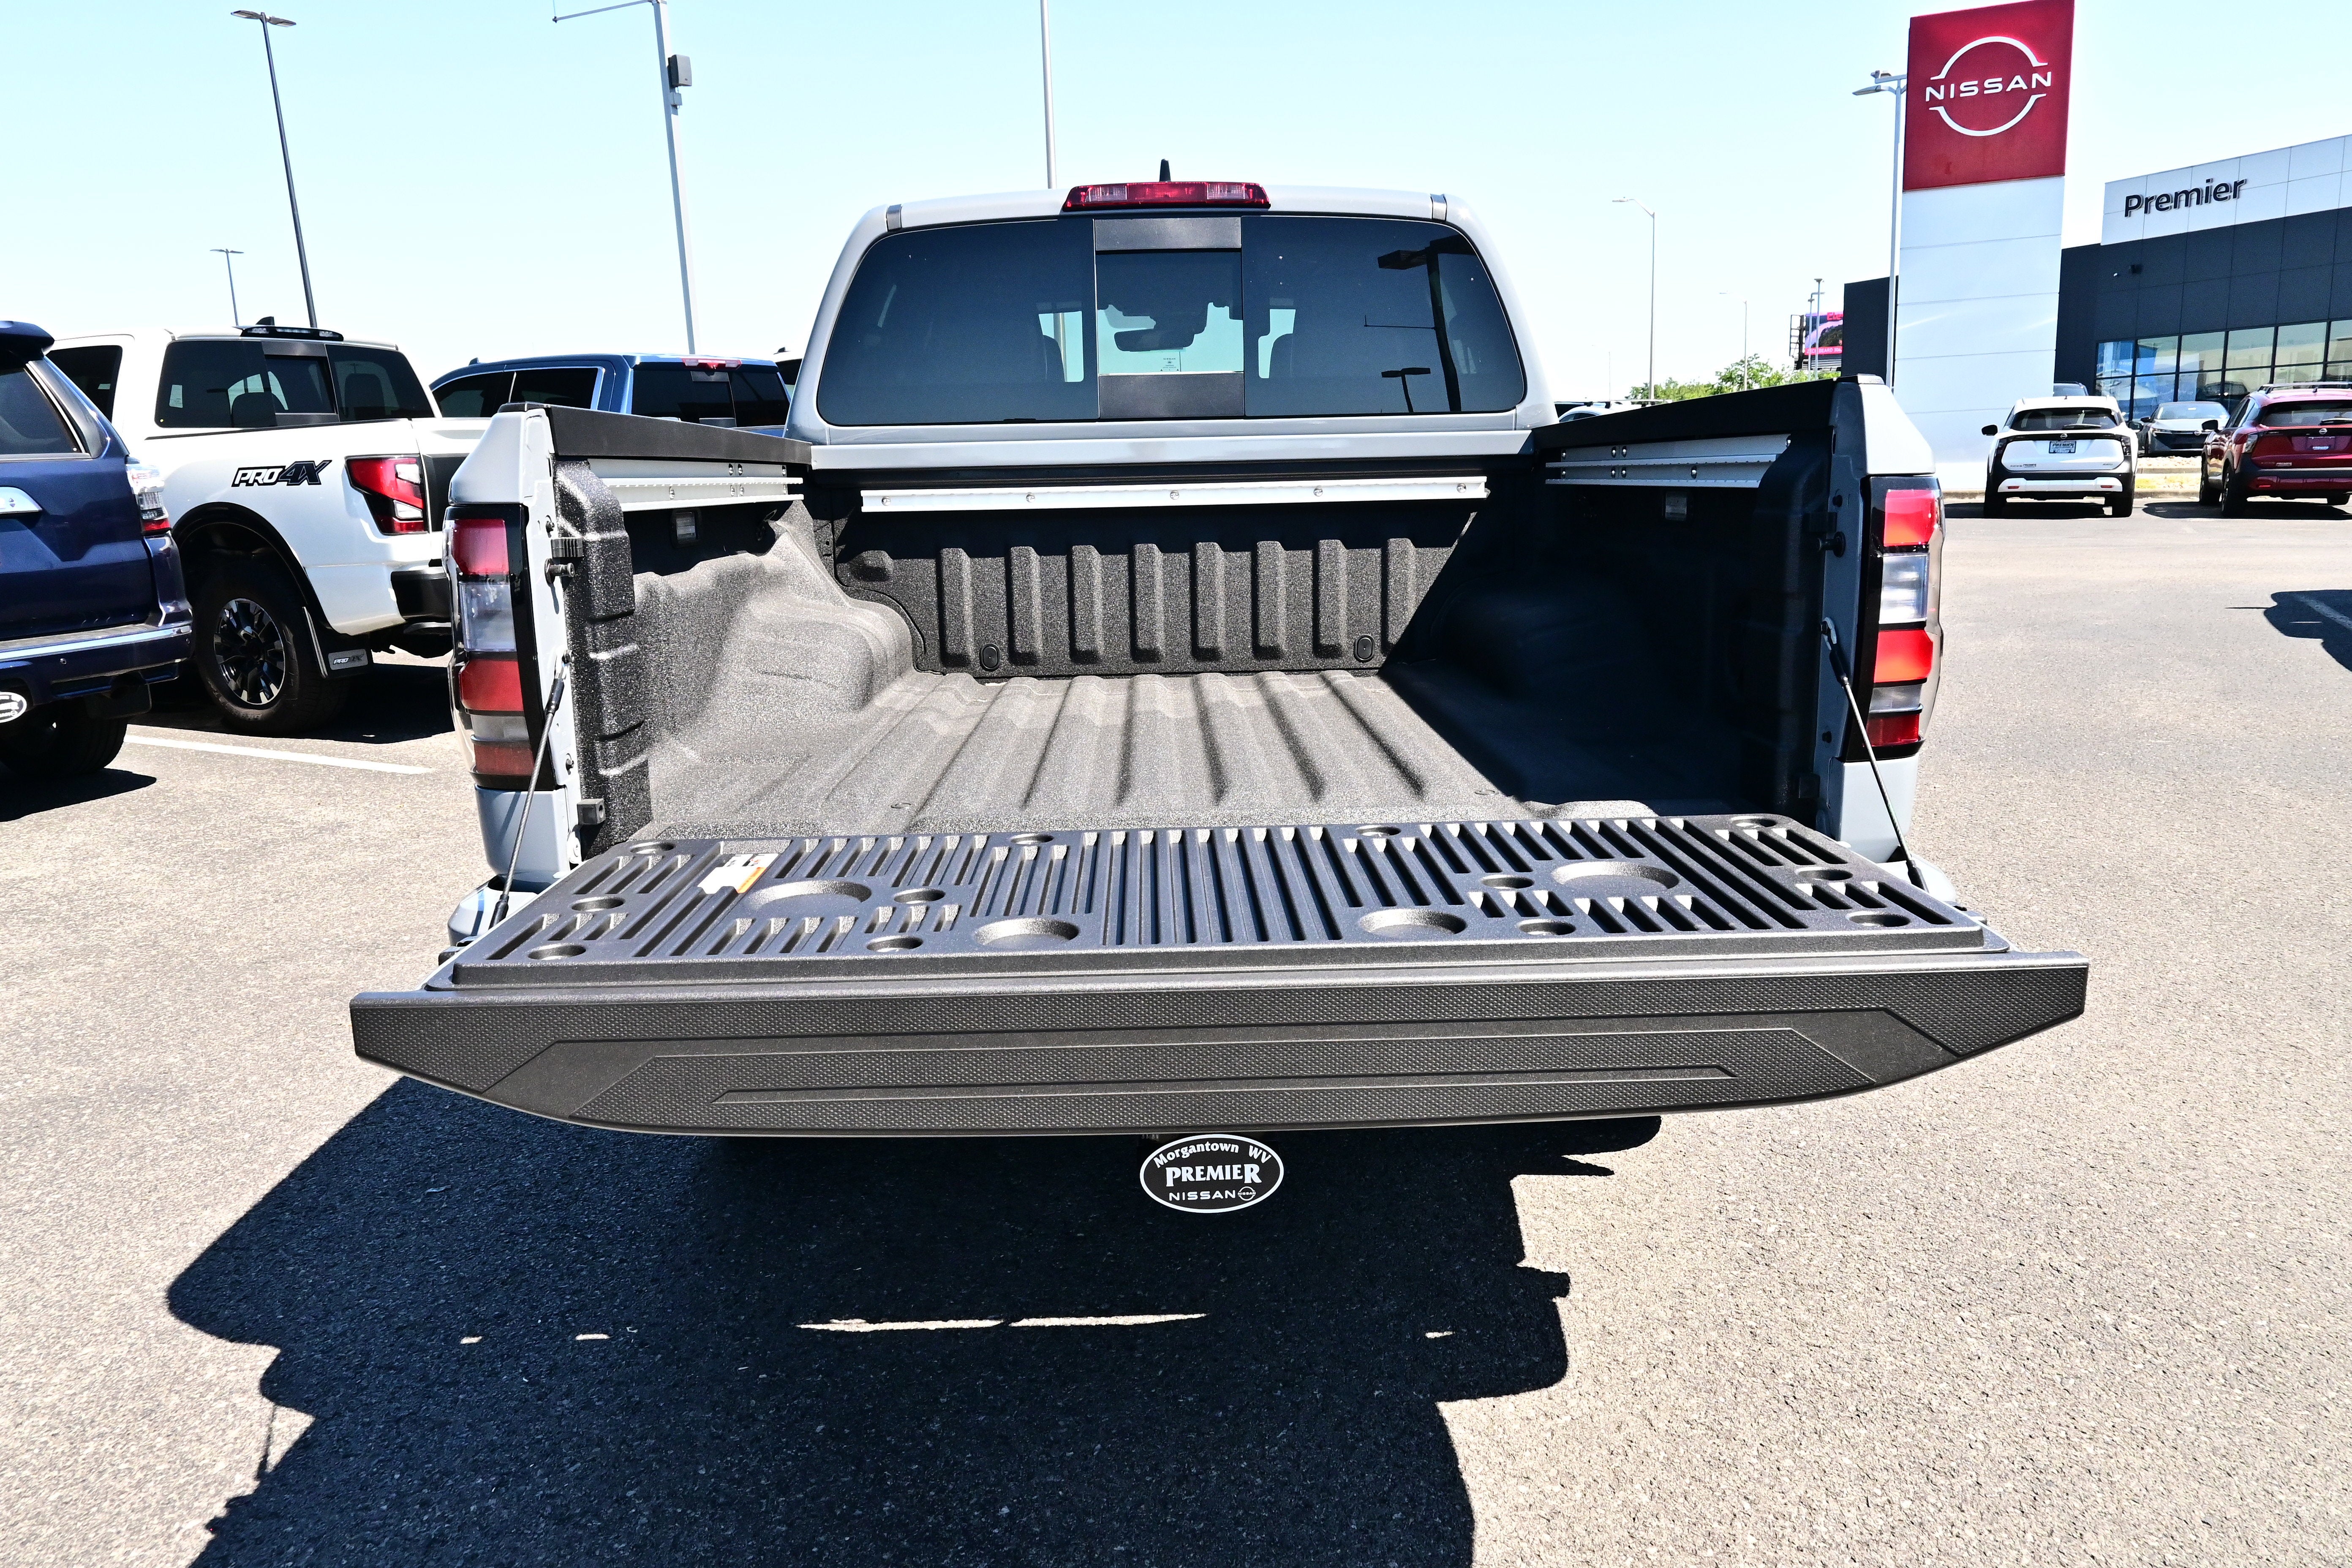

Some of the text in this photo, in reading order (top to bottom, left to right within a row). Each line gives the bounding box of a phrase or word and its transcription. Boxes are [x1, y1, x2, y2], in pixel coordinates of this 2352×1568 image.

[1925, 71, 2052, 102] NISSAN
[2124, 178, 2247, 217] Premier
[1153, 1141, 1272, 1168] Morgantown WV
[1165, 1163, 1262, 1187] PREMIER
[1169, 1190, 1236, 1201] NISSAN
